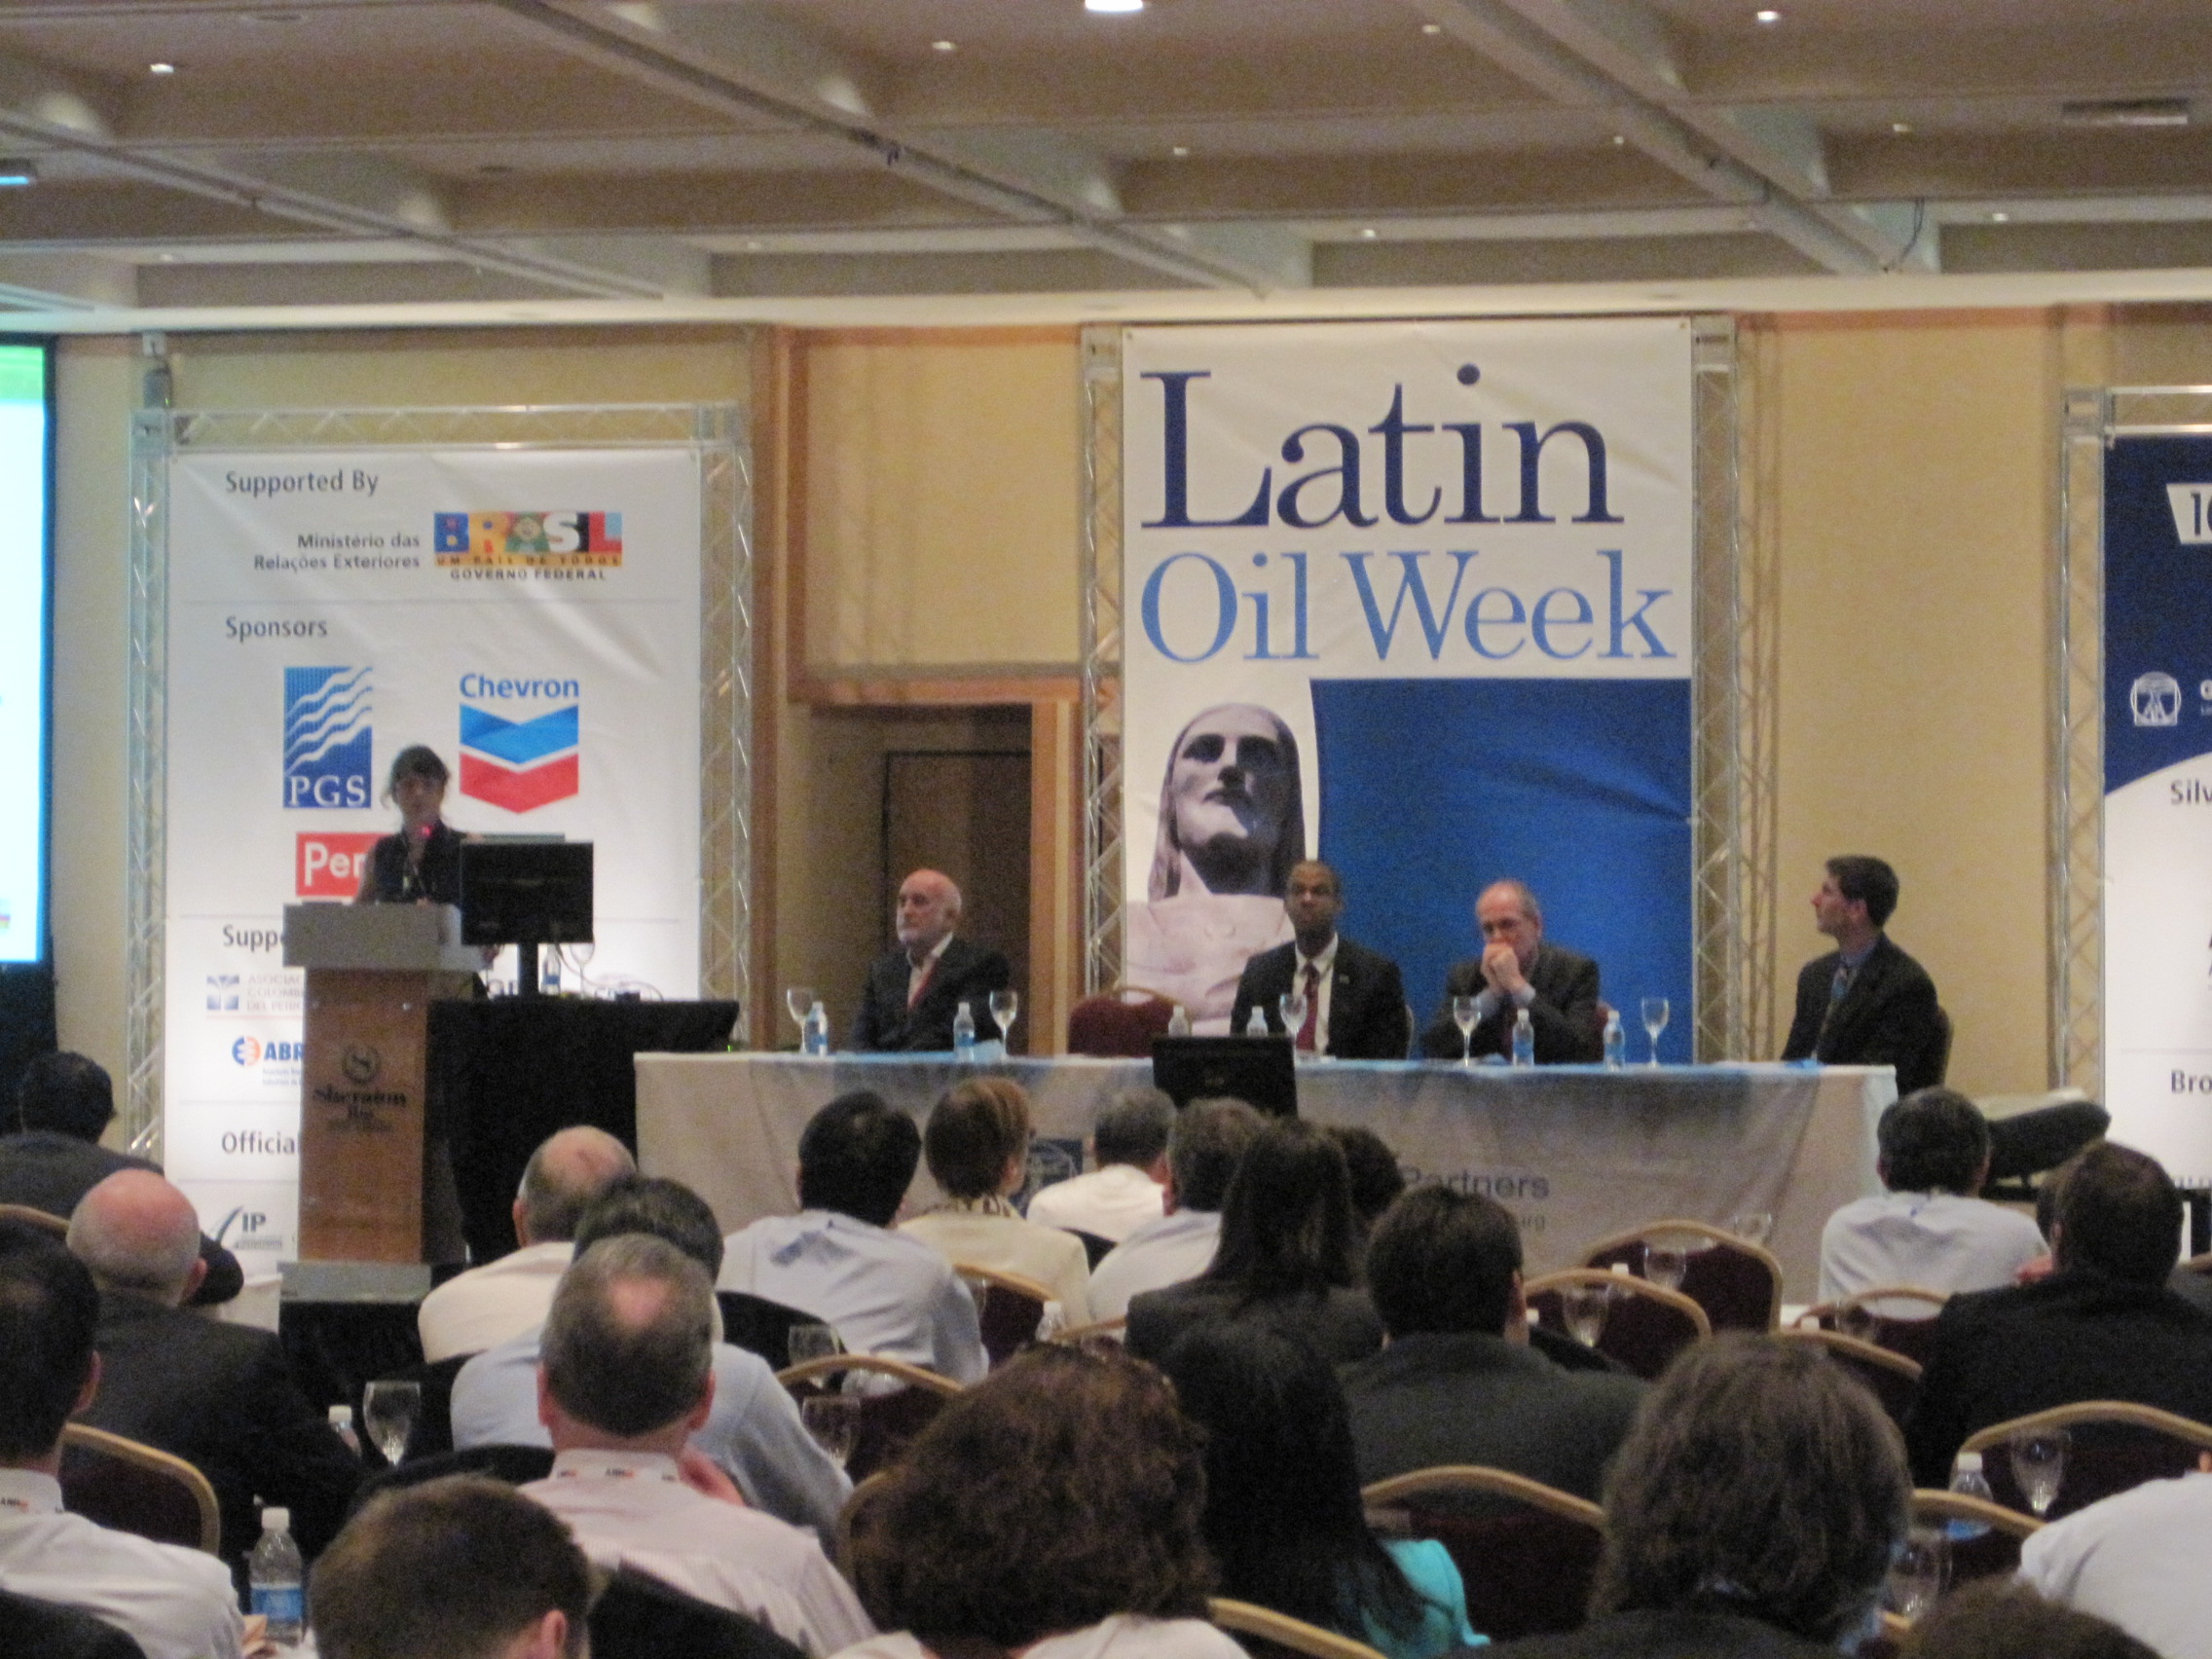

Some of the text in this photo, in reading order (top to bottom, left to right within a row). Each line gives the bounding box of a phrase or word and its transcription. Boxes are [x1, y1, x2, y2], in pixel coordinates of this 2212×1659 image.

[1140, 362, 1625, 530] Latin
[225, 468, 379, 498] Supported By
[2191, 492, 2212, 536] 1
[390, 532, 421, 548] das
[333, 554, 421, 571] Exteriores
[450, 568, 607, 581] GOVERNO FEDERAL
[1140, 548, 1678, 664] Oil Week
[225, 615, 327, 644] Sponsors
[459, 672, 580, 699] Chevron
[290, 774, 366, 807] PGS
[222, 923, 286, 953] Supp
[241, 1213, 267, 1233] IP
